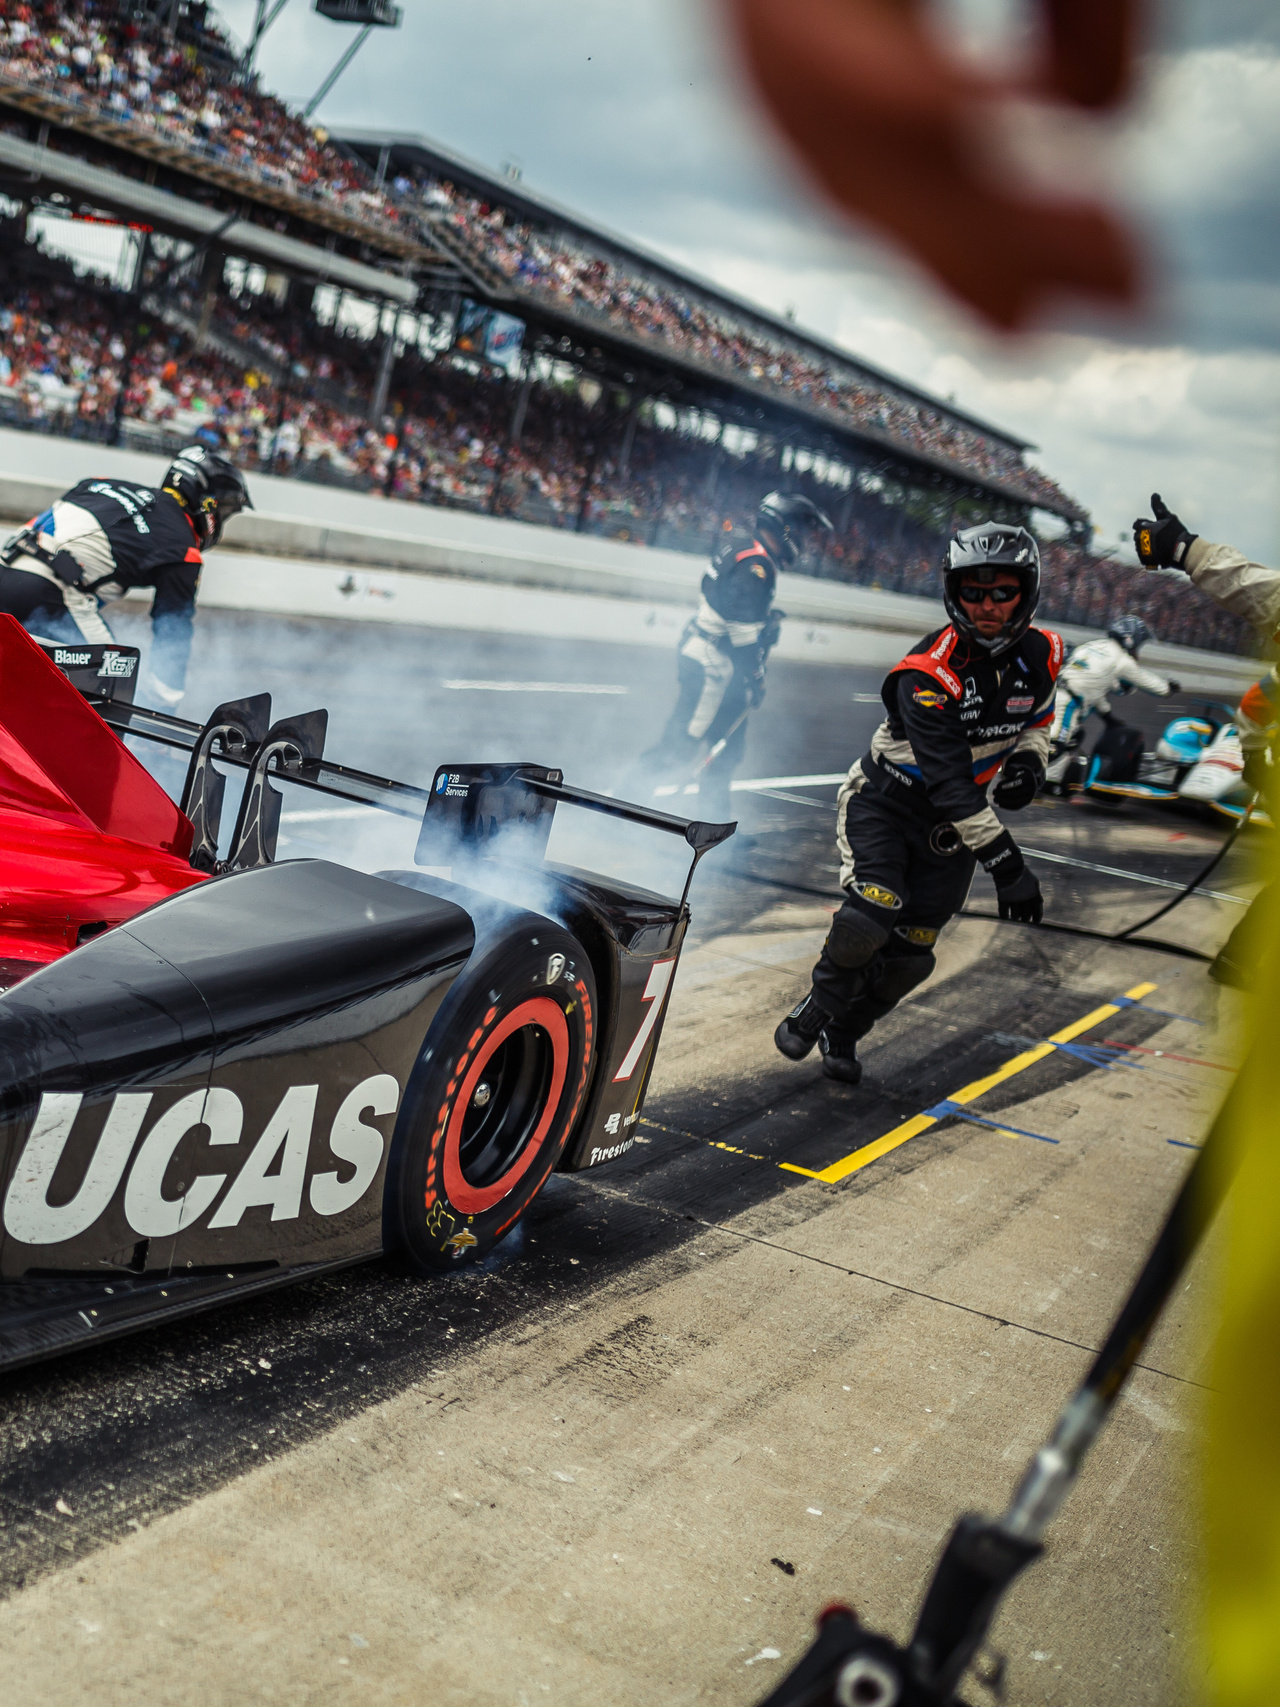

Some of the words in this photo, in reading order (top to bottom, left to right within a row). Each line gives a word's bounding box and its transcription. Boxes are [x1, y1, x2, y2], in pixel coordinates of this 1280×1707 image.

[54, 649, 92, 665] Blauer
[445, 786, 469, 797] Services
[613, 956, 677, 1083] 7
